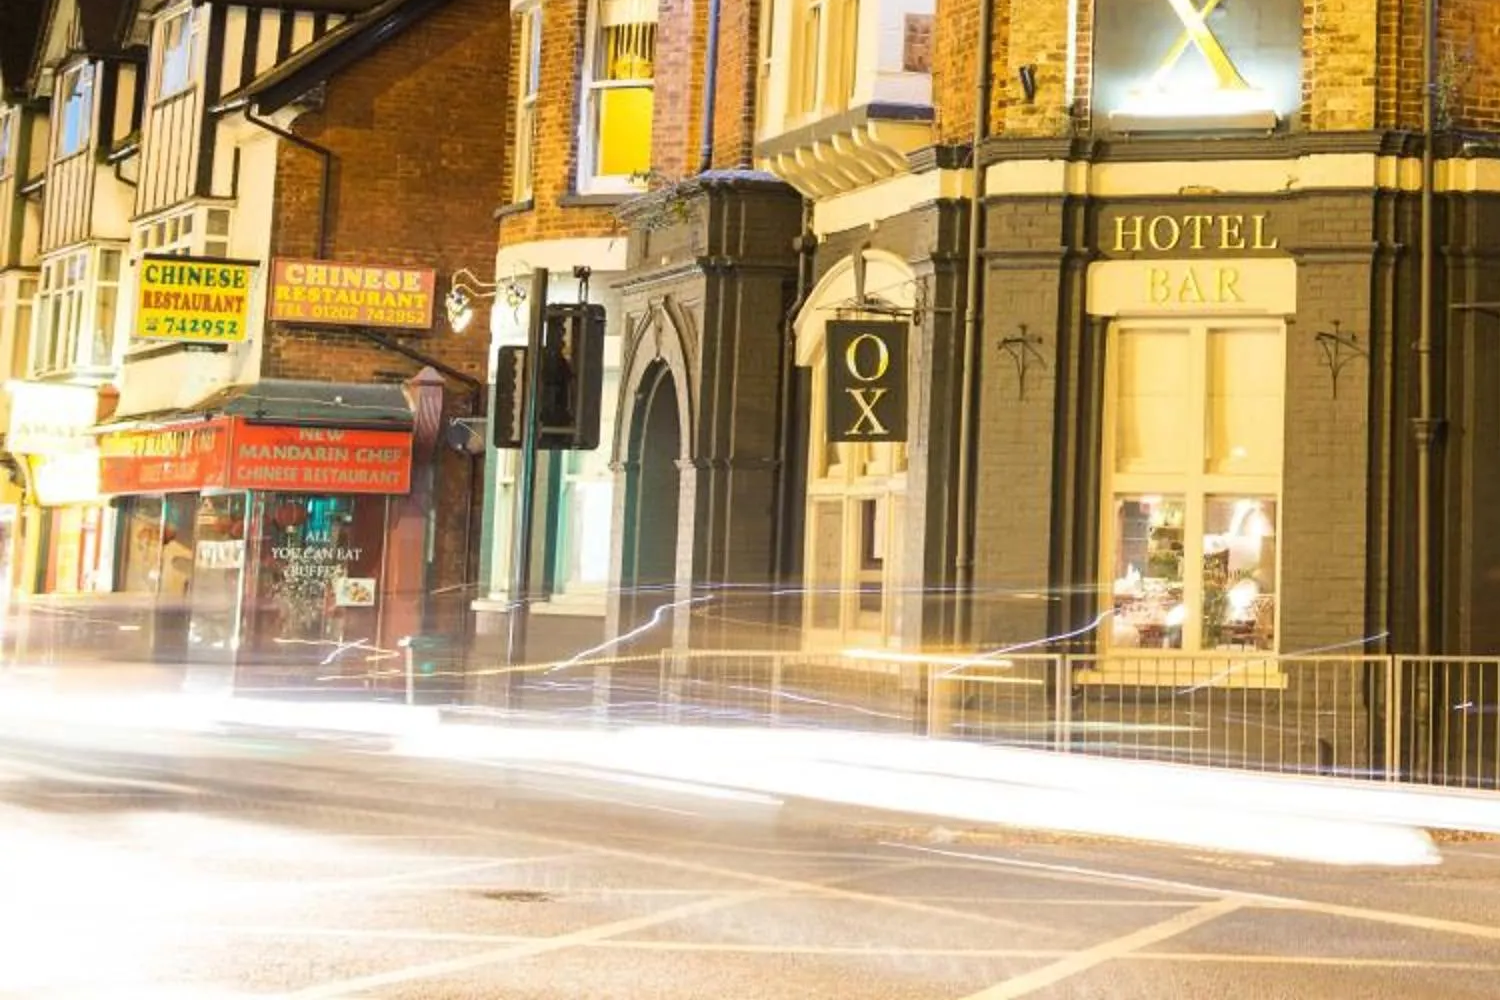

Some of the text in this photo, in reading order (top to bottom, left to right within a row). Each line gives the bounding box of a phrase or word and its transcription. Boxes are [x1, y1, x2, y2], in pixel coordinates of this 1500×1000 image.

[1112, 212, 1279, 252] HOTEL
[145, 264, 246, 289] CHINESE
[285, 264, 422, 291] CHINESE
[1143, 266, 1246, 304] BAR
[143, 290, 245, 313] RESTAURANT
[275, 284, 428, 308] RESTAURANT
[311, 305, 360, 320] 01202
[163, 316, 239, 336] 742952
[844, 333, 890, 436] OX
[299, 428, 346, 441] NEW
[238, 444, 402, 465] MANDARIN CHEF
[237, 465, 401, 484] CHINESE RESTAURANT
[305, 530, 331, 542] ALL
